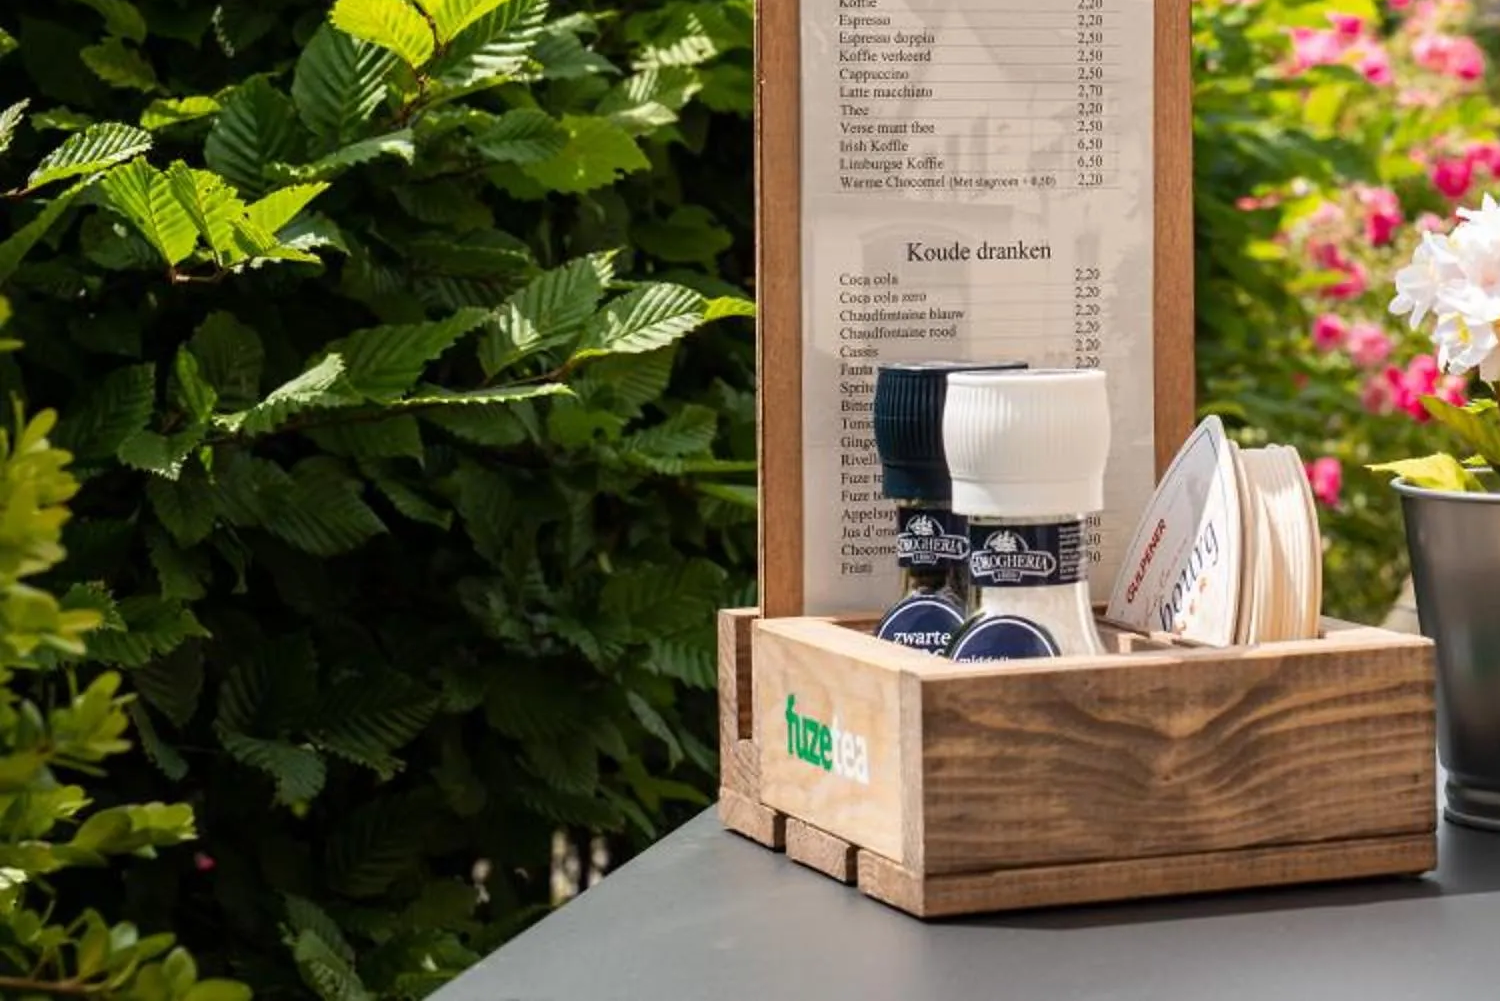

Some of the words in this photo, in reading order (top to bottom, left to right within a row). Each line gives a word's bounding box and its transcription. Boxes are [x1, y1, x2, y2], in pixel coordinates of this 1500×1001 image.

[839, 15, 891, 28] Espresso
[1077, 14, 1103, 27] 2,20
[839, 32, 891, 46] Espresso
[893, 31, 935, 46] doppio
[1077, 32, 1103, 45] 2,50
[839, 50, 878, 62] Koffie
[881, 49, 931, 62] verkeerd
[1077, 50, 1103, 63] 2,50
[839, 68, 909, 83] Cappuccino
[1077, 67, 1103, 81] 2,50
[839, 86, 869, 98] Latte
[873, 86, 933, 98] macchiato
[1077, 85, 1103, 98] 2,70
[840, 104, 869, 116] Thee
[1077, 103, 1103, 116] 2,20
[840, 122, 874, 134] Verse
[877, 124, 908, 134] munt
[911, 121, 935, 133] thee
[1077, 120, 1103, 133] 2,50
[840, 141, 867, 152] Irish
[871, 140, 909, 152] Koffie
[1077, 138, 1103, 151] 6,50
[839, 159, 903, 173] Limburgse
[906, 158, 945, 170] Koffie
[1077, 156, 1103, 169] 6,50
[840, 177, 882, 189] Warme
[885, 176, 945, 188] Chocomel
[1077, 174, 1103, 187] 2,20
[907, 242, 970, 261] Koude
[977, 241, 1051, 260] dranken
[839, 273, 870, 286] Coca
[873, 273, 898, 285] cola
[839, 292, 870, 304] Coca
[873, 291, 898, 303] cola
[839, 309, 926, 321] Chaudfontaine
[929, 308, 965, 320] blauw
[839, 327, 927, 340] Chaudfontaine
[929, 325, 957, 338] rood
[839, 345, 879, 358] Cassis
[840, 363, 873, 376] Fanta
[841, 454, 877, 466] Rivell
[841, 472, 869, 484] Fuze
[841, 490, 869, 502] Fuze
[842, 526, 861, 539] Jus
[841, 544, 897, 557] Chocome
[974, 554, 1048, 573] DROGHERIA
[893, 630, 951, 646] zwarte
